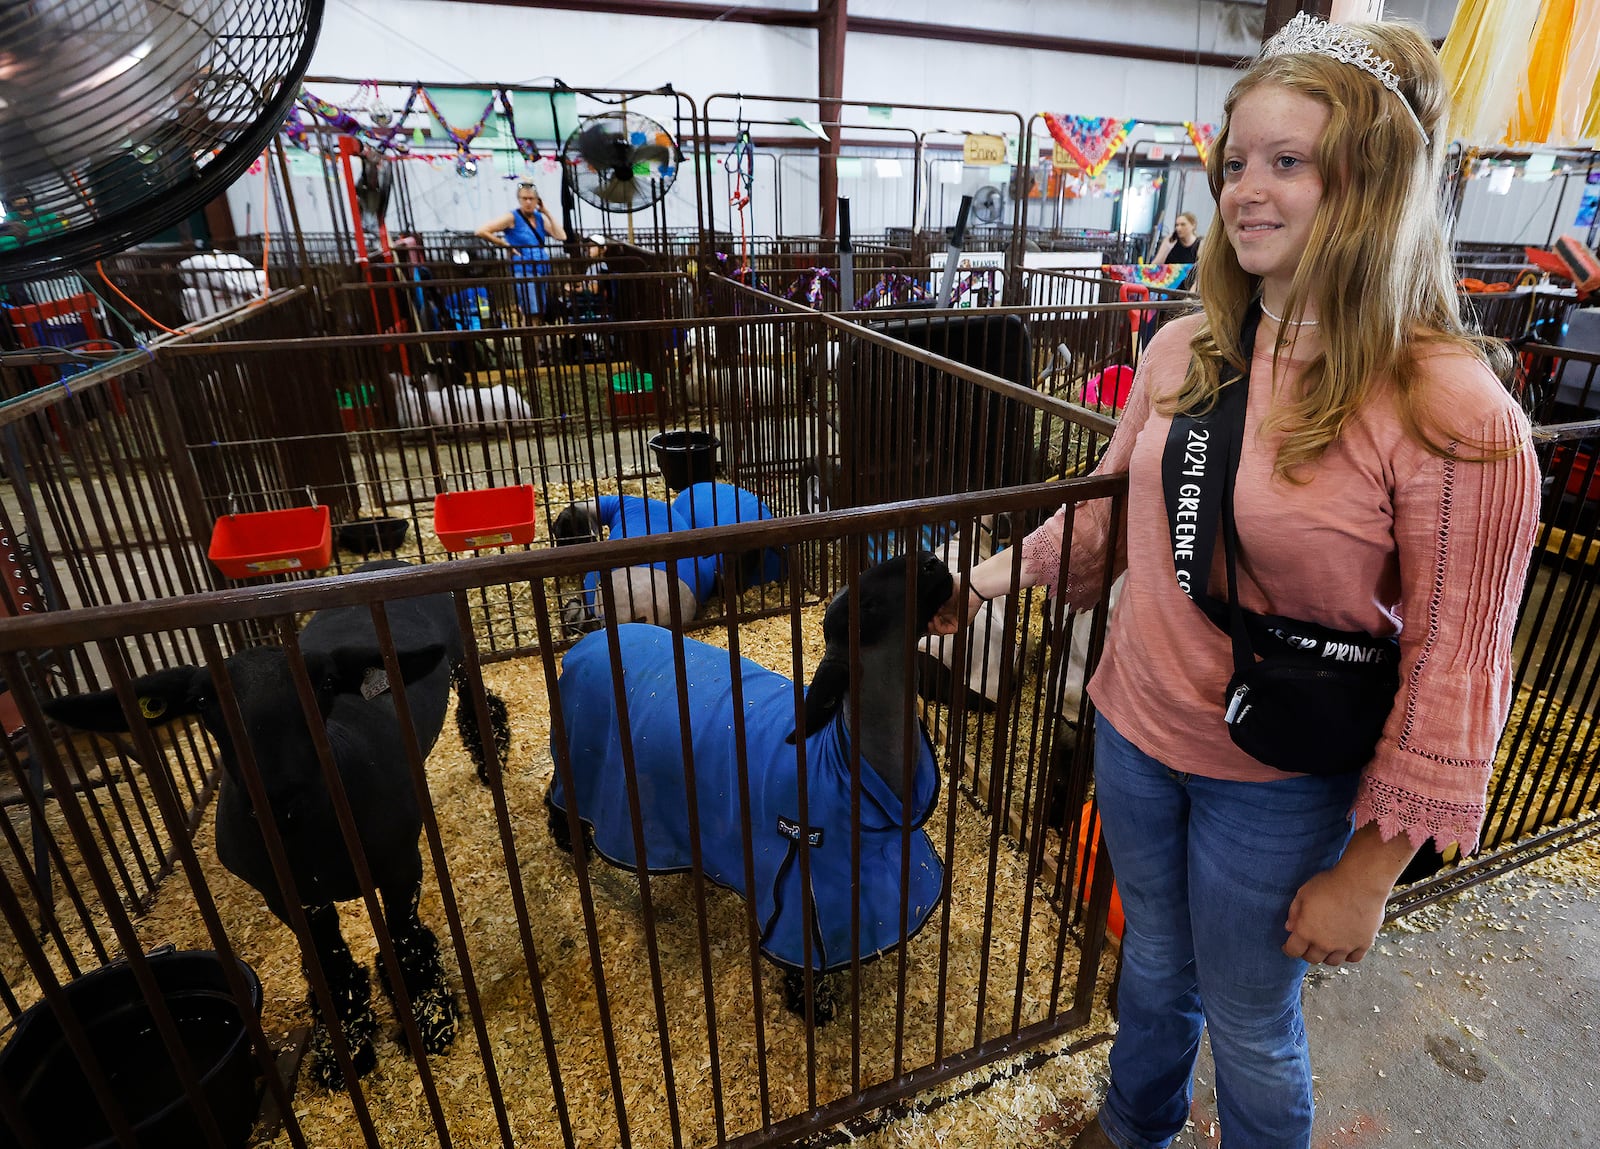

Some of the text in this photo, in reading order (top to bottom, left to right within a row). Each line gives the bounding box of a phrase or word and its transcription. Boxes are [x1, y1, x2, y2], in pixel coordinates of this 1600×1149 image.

[1175, 429, 1210, 600] 2024 GREENE CO
